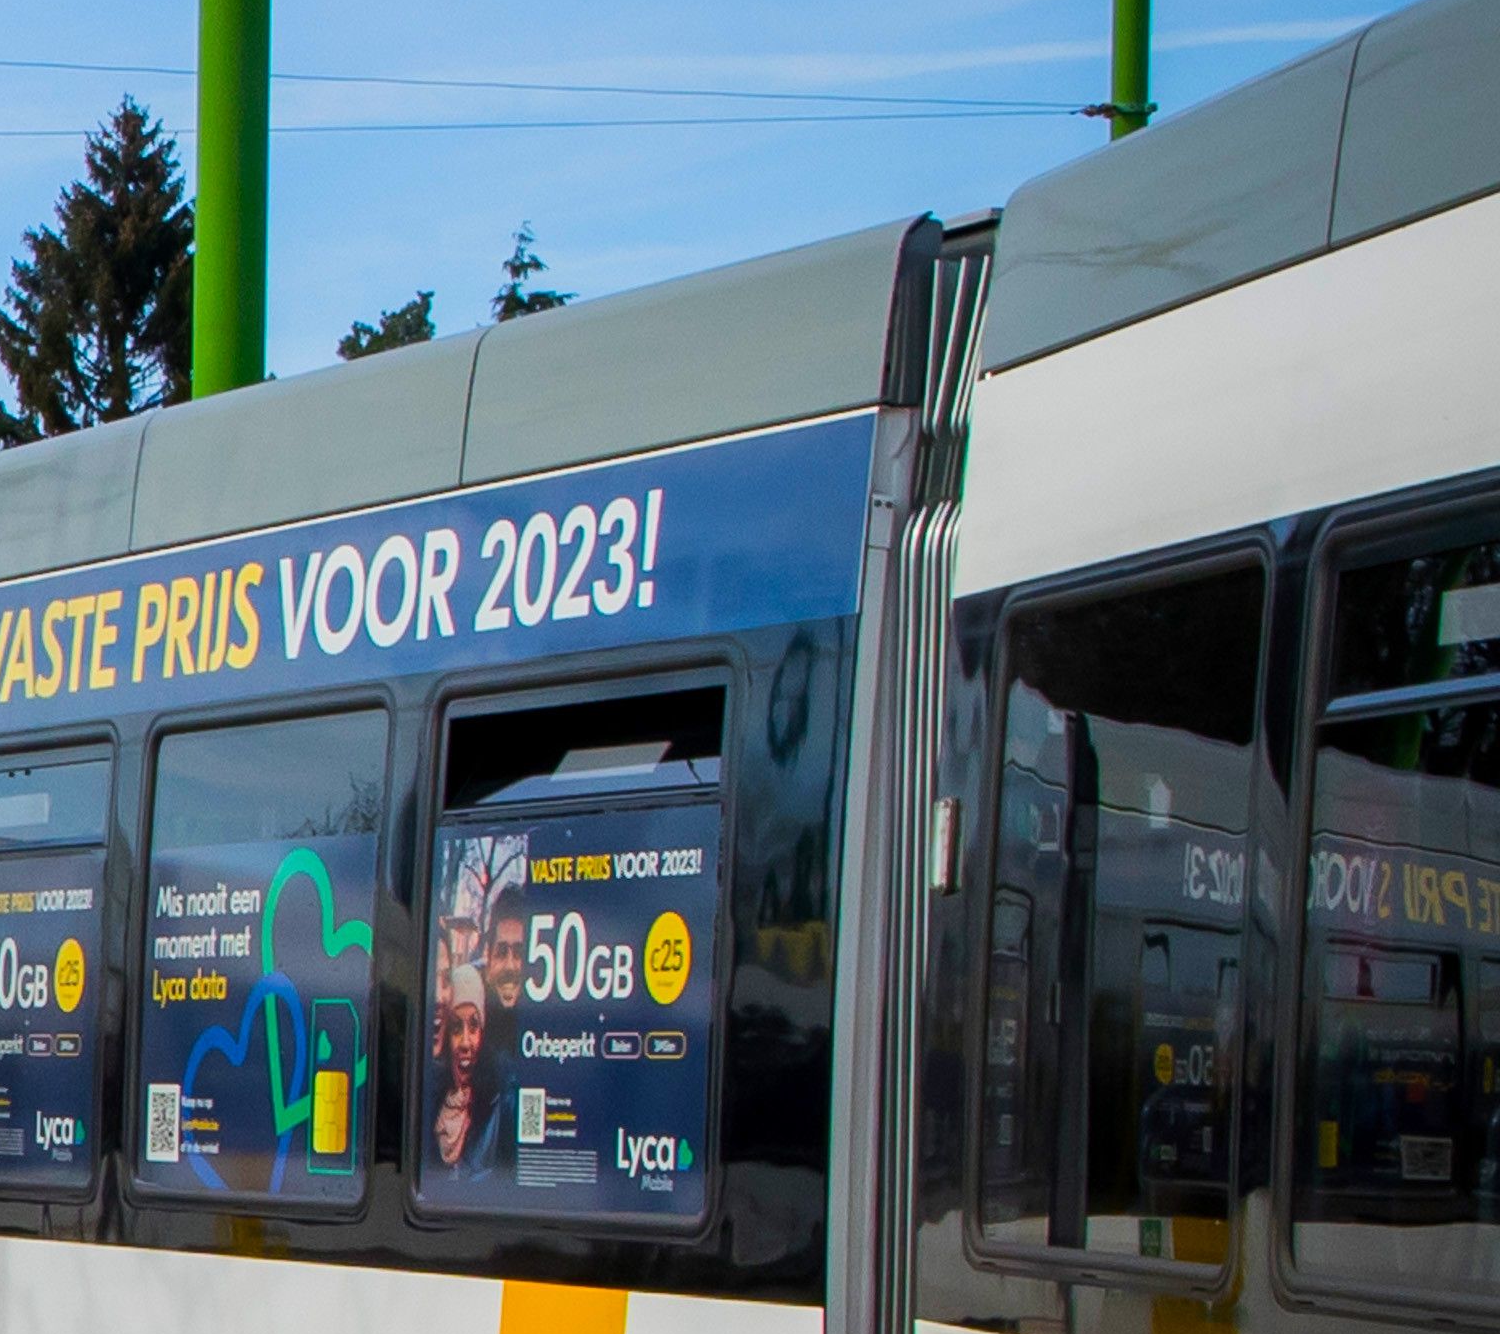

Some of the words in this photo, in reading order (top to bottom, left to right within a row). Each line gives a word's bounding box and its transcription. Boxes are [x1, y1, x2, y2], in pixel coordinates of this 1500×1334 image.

[131, 561, 264, 683] PRIJS
[279, 528, 460, 661] VOOR
[474, 488, 663, 633] 2023!
[530, 857, 574, 884] VASTE
[613, 851, 659, 879] VOOR
[156, 885, 184, 918] Mis
[187, 882, 227, 916] nooit
[230, 889, 261, 915] een
[154, 926, 217, 959] moment
[220, 925, 251, 957] met
[525, 912, 634, 1002] 50GB
[153, 969, 186, 1009] Lyca
[190, 967, 228, 1000] data
[522, 1030, 596, 1065] Onbeperkt
[36, 1110, 75, 1150] Lyca
[617, 1127, 675, 1178] Lyca
